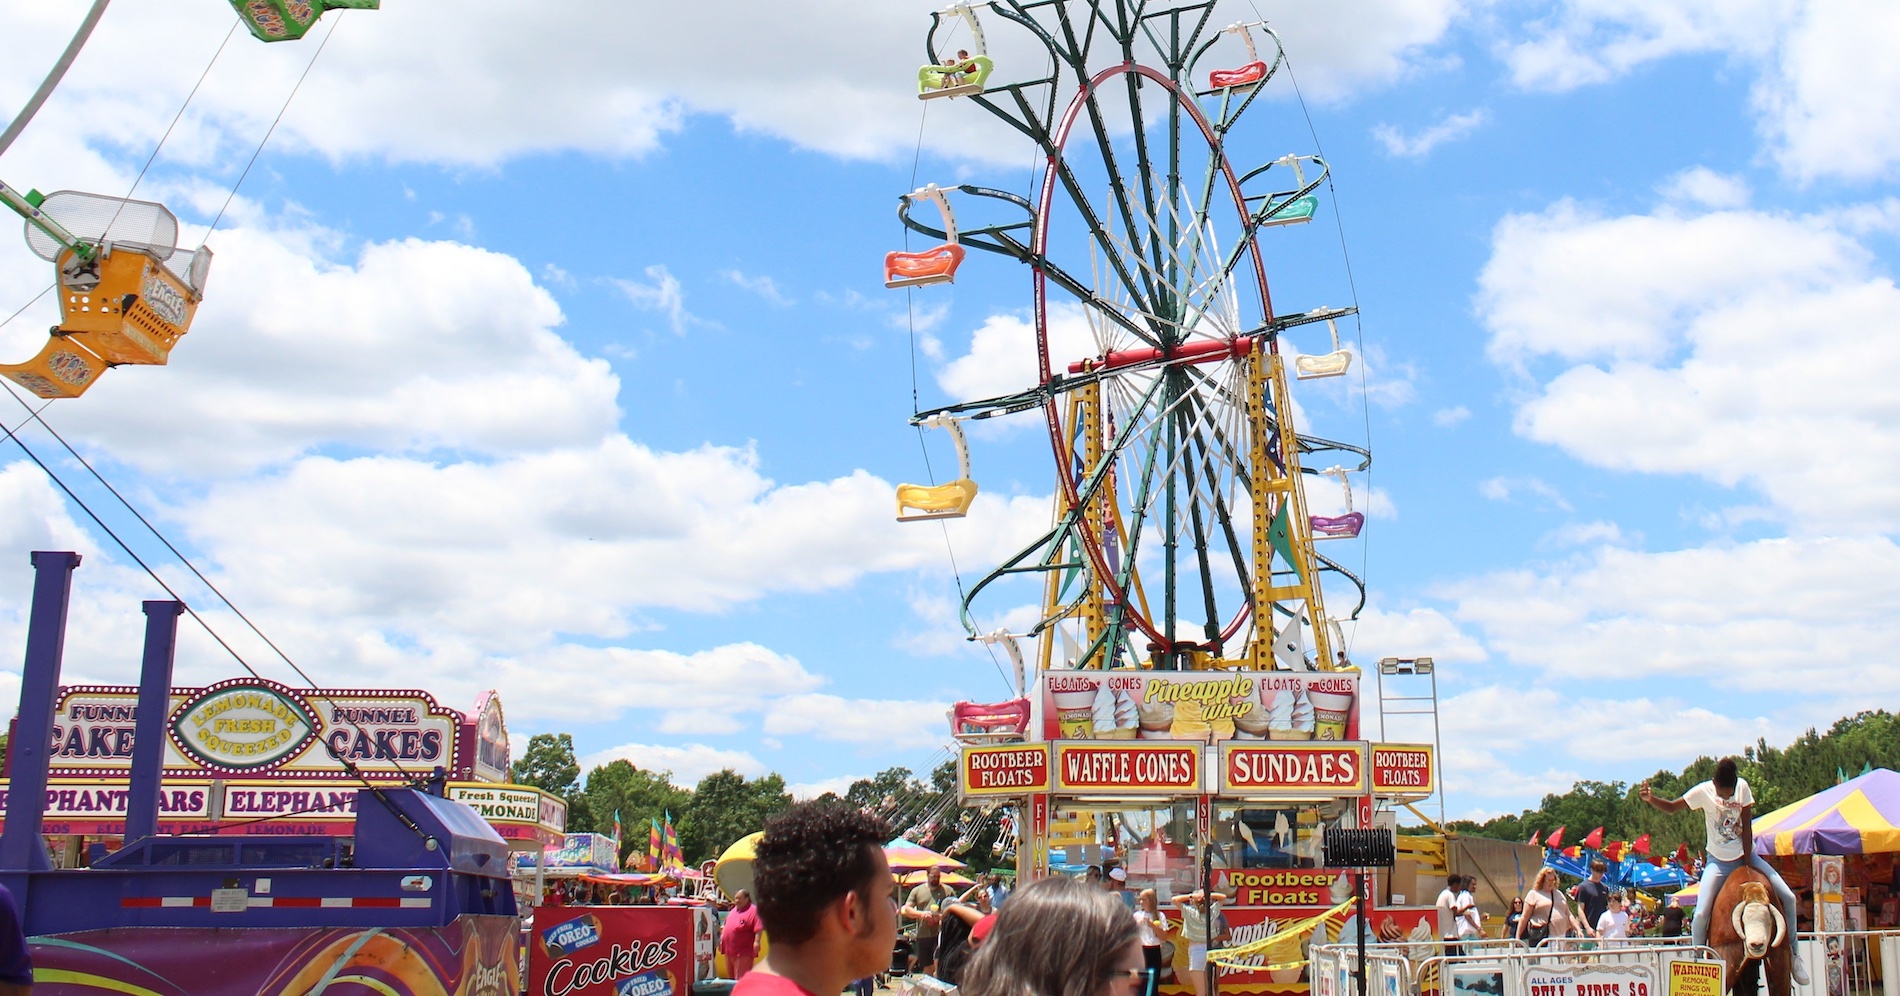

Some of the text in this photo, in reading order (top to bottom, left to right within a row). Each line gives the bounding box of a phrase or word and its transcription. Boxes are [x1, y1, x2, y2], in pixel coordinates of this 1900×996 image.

[1048, 675, 1142, 691] FLOATS CONES
[1143, 673, 1253, 706] Pineapple
[1261, 678, 1352, 692] FLOATS CONES
[69, 704, 138, 723] FUNN
[191, 694, 299, 728] LEMONADE
[330, 707, 419, 725] FUNNEL
[1201, 700, 1253, 722] Whip
[213, 718, 276, 734] FRESH
[50, 725, 137, 760] CAKE
[197, 728, 293, 756] SQUEEZED
[326, 728, 443, 762] CAKES
[971, 751, 1043, 770] ROOTBEER
[1066, 752, 1191, 784] WAFFLE CONES
[1233, 752, 1355, 784] SUNDAES
[1375, 751, 1427, 768] ROOTBEER
[982, 769, 1034, 787] FLOATS
[1383, 770, 1420, 786] FLOATS
[157, 790, 204, 813] ARS
[458, 790, 537, 804] Fresh Squeezed
[42, 824, 70, 834] EOS
[246, 825, 327, 835] LEMONADE
[1229, 872, 1337, 888] Rootbeer
[1248, 889, 1319, 905] Floats
[558, 925, 591, 946] OREO
[575, 935, 599, 948] COOKIES
[544, 936, 678, 996] Cookies
[1672, 964, 1720, 980] WARNING!
[476, 960, 502, 992] EAGLE
[1531, 976, 1573, 985] ALL AGES
[1682, 976, 1709, 985] REMOVE
[631, 978, 664, 996] OREO
[1680, 984, 1711, 993] RINGS ON
